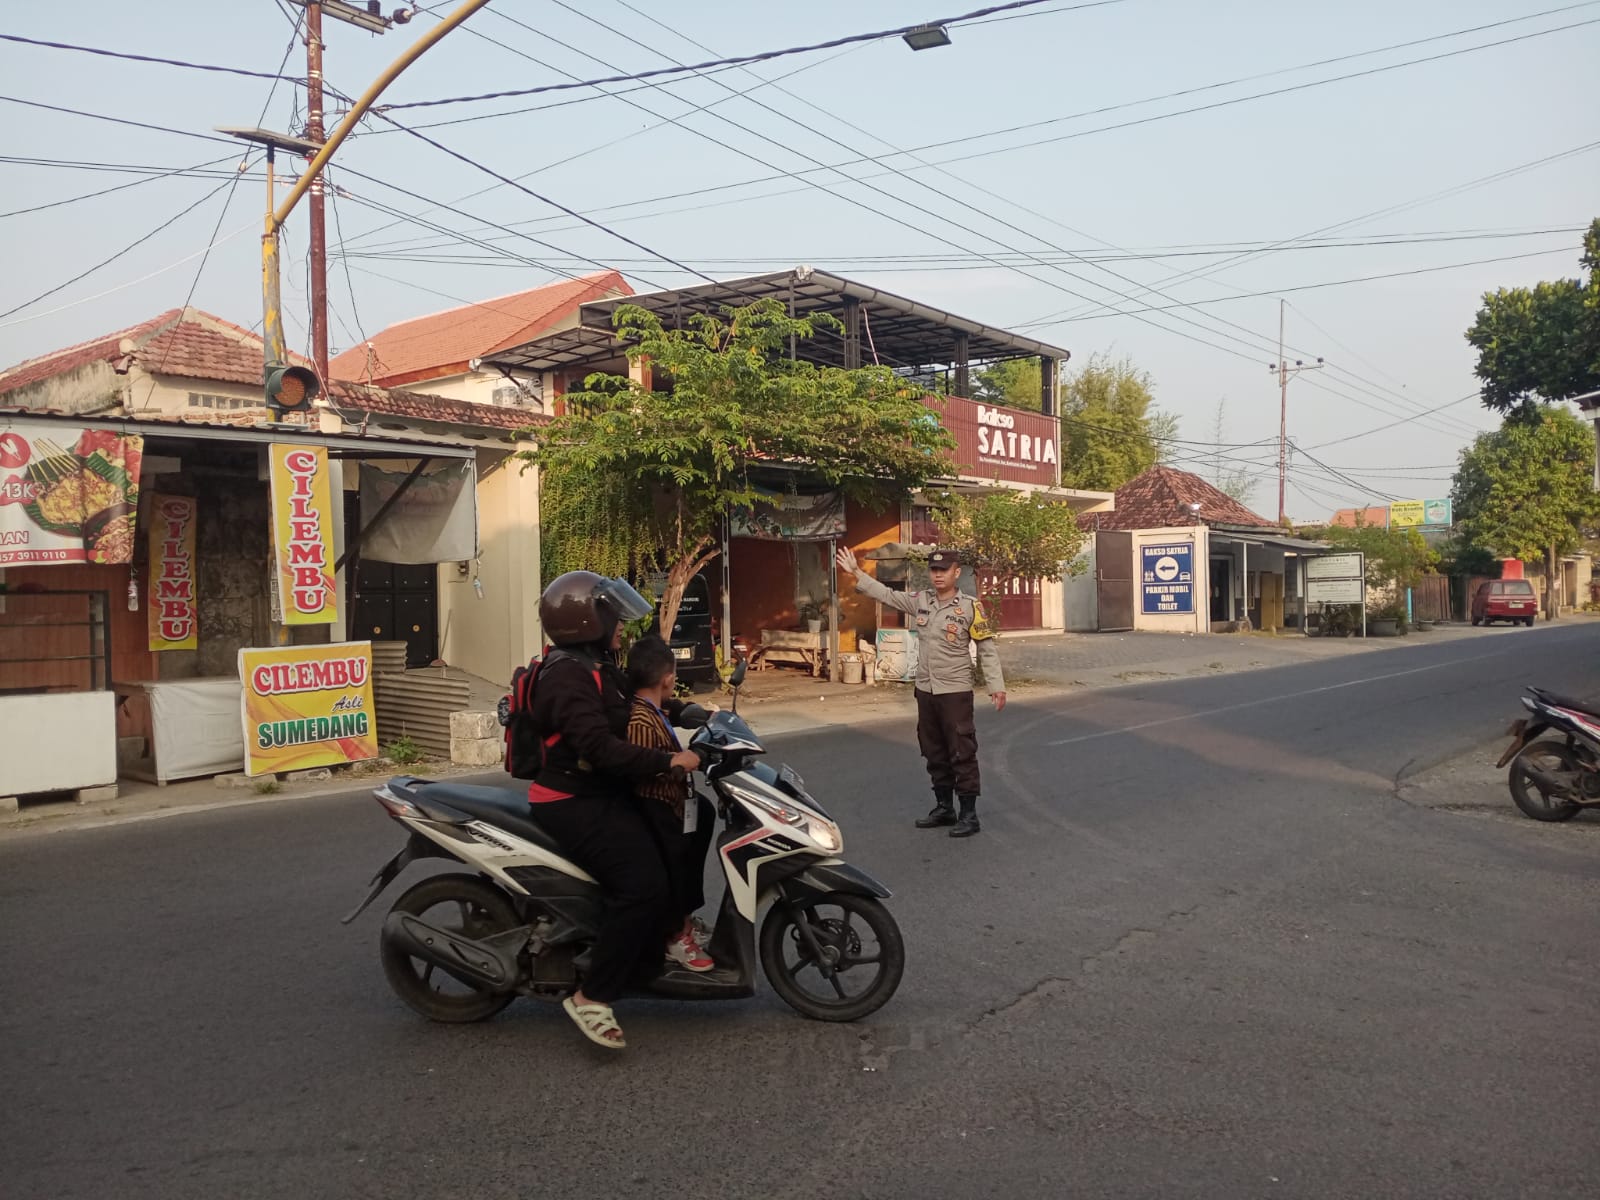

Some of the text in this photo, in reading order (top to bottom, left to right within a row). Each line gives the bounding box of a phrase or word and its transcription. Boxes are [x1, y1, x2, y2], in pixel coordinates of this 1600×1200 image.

[977, 405, 1014, 429] Bakso
[977, 426, 1056, 464] SATRIA
[285, 452, 324, 611] CILEMBU
[17, 552, 39, 561] 3911
[42, 551, 67, 560] 9110
[158, 502, 192, 639] CILEMBU
[253, 657, 367, 695] CILEMBU
[331, 695, 363, 711] Asli
[257, 711, 369, 748] SUMEDANG
